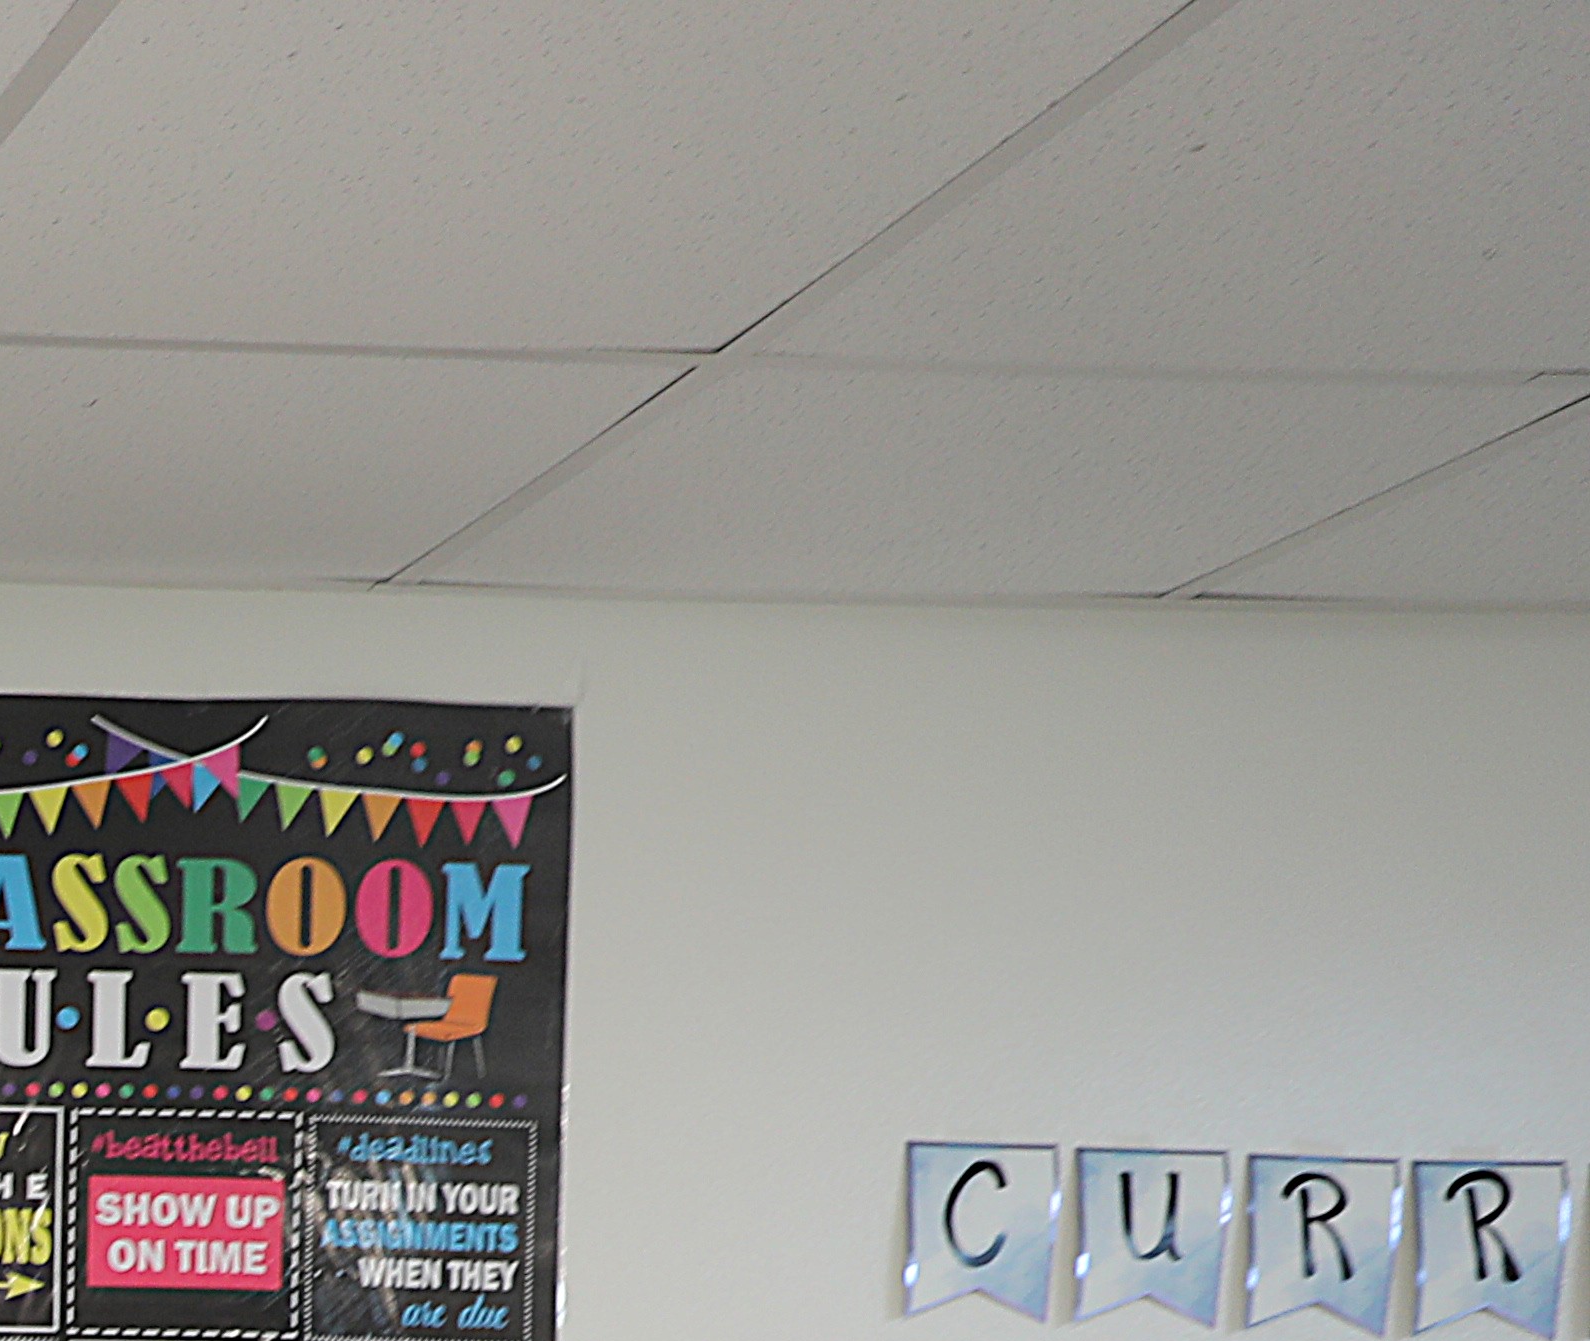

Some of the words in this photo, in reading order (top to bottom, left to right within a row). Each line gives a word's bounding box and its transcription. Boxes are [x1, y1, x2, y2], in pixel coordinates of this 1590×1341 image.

[337, 1132, 493, 1166] #deadlines
[95, 1191, 215, 1229] SHOW
[224, 1193, 280, 1231] UP
[326, 1179, 402, 1213] TURN
[407, 1181, 437, 1214] IN
[441, 1183, 522, 1216] YOUR
[321, 1218, 520, 1253] ASSIGNMENTS
[943, 1159, 1522, 1283] CURR
[106, 1238, 166, 1273] ON
[173, 1238, 268, 1275] TIME
[358, 1258, 443, 1289] WHEN
[447, 1260, 520, 1292] THEY
[401, 1300, 448, 1328] are
[458, 1292, 510, 1330] due
